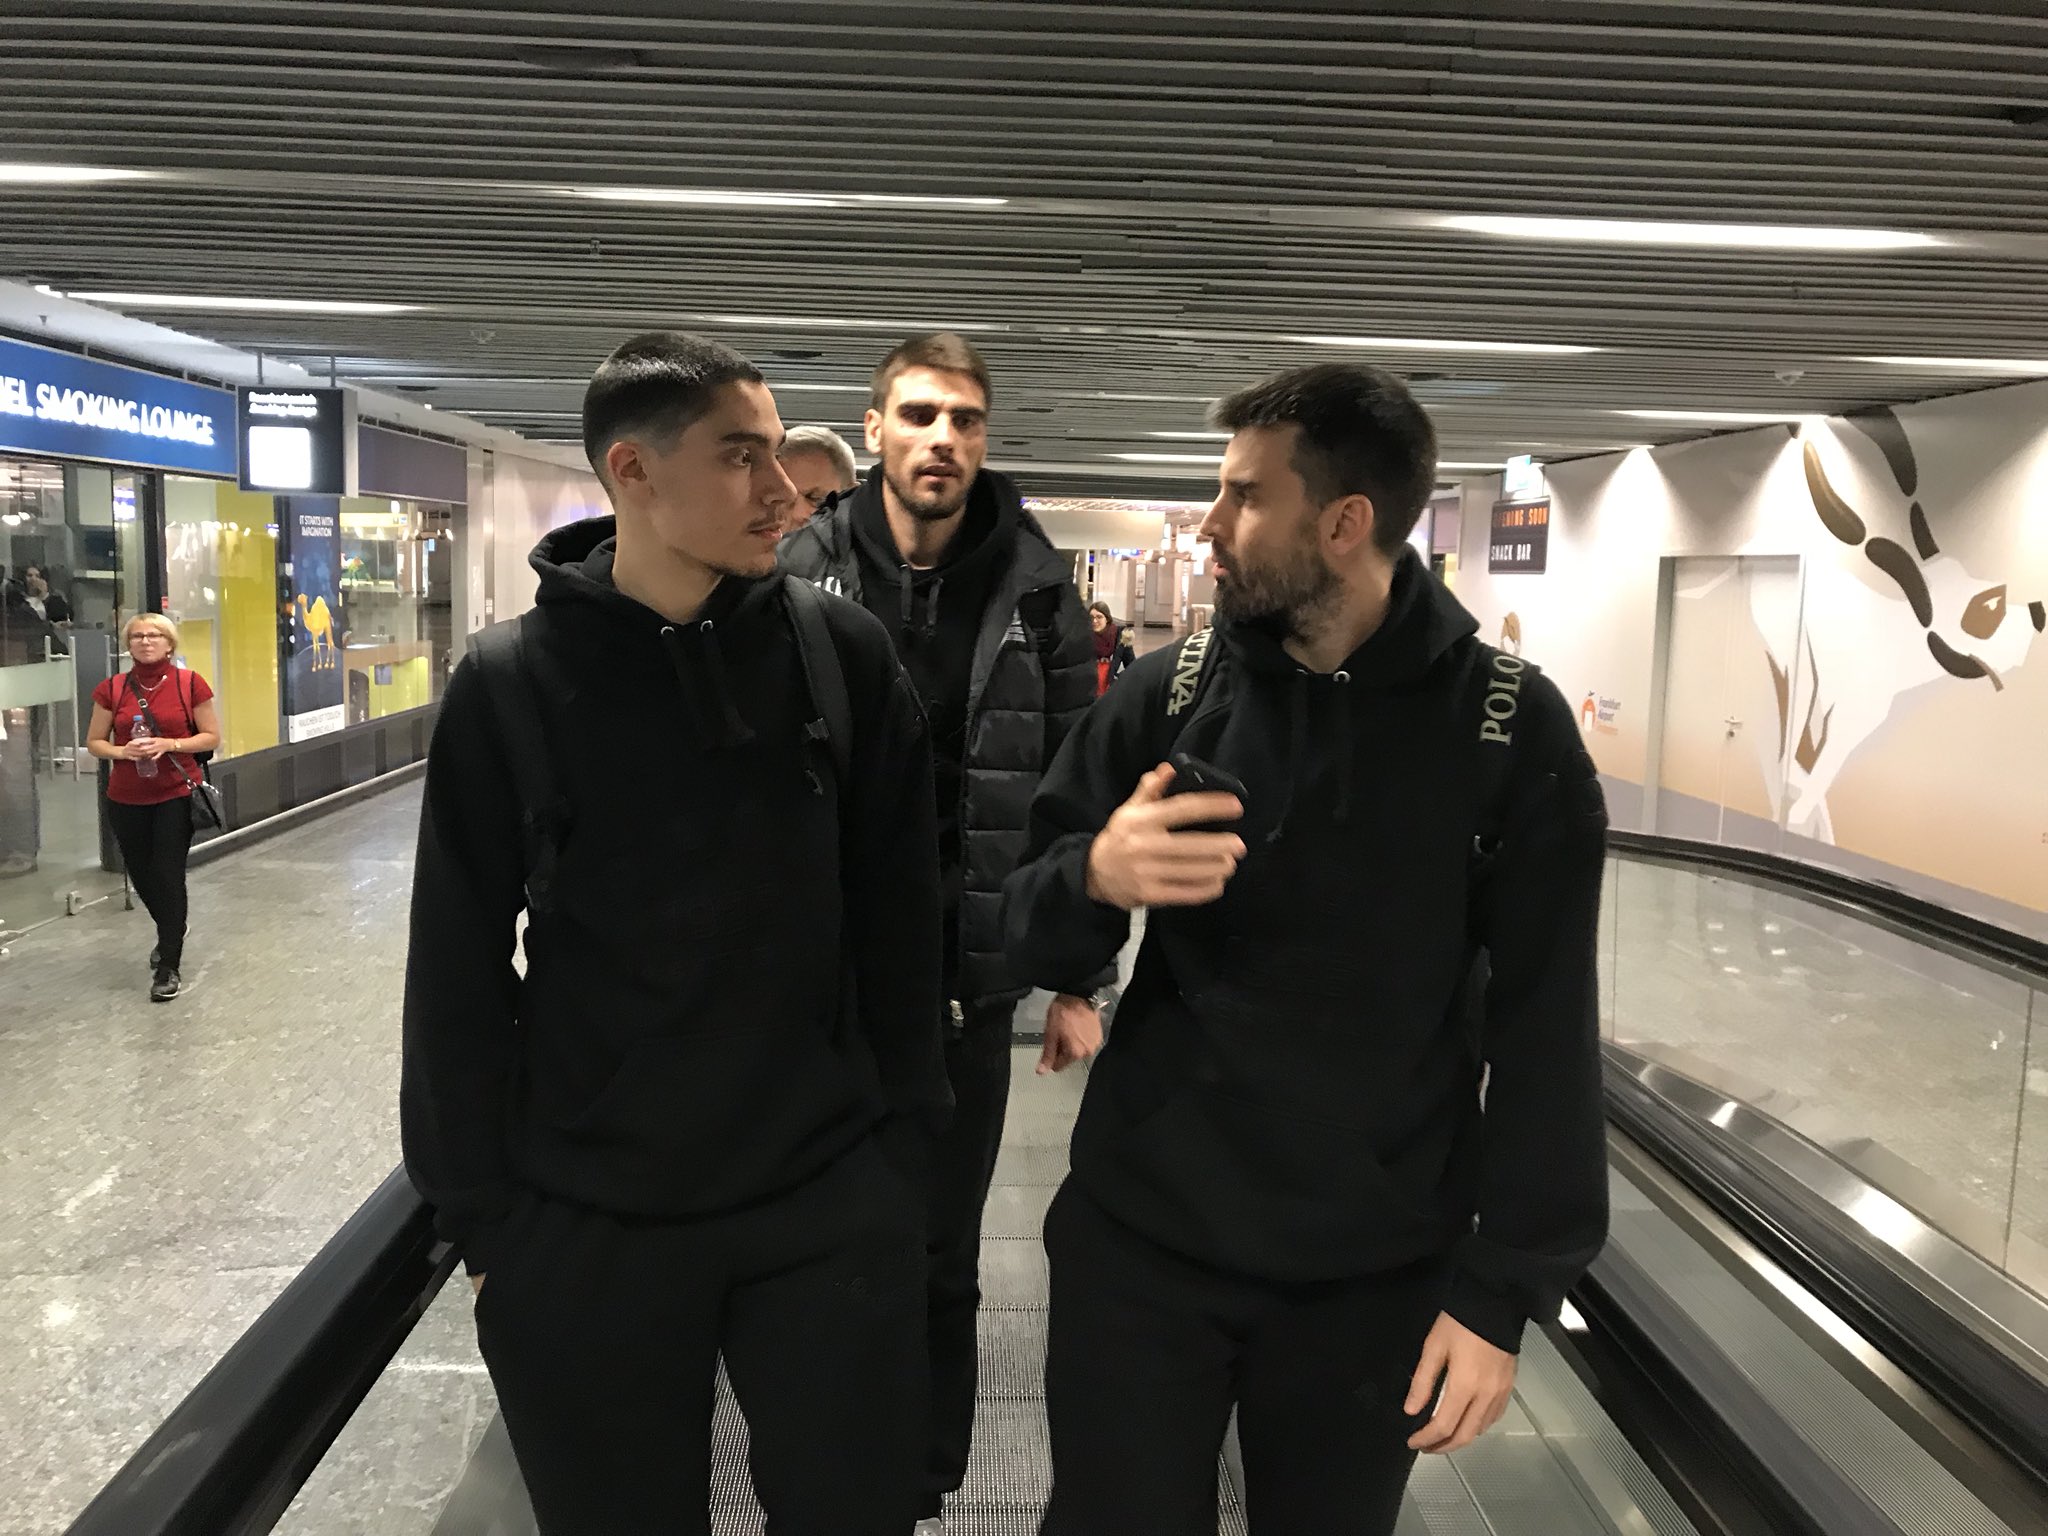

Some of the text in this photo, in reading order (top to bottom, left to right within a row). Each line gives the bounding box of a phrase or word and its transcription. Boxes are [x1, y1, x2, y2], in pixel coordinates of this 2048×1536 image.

[36, 383, 140, 433] SMOKING
[140, 403, 215, 446] LOUNGE
[1491, 543, 1532, 561] SNACK BAR
[1479, 655, 1525, 746] POLO
